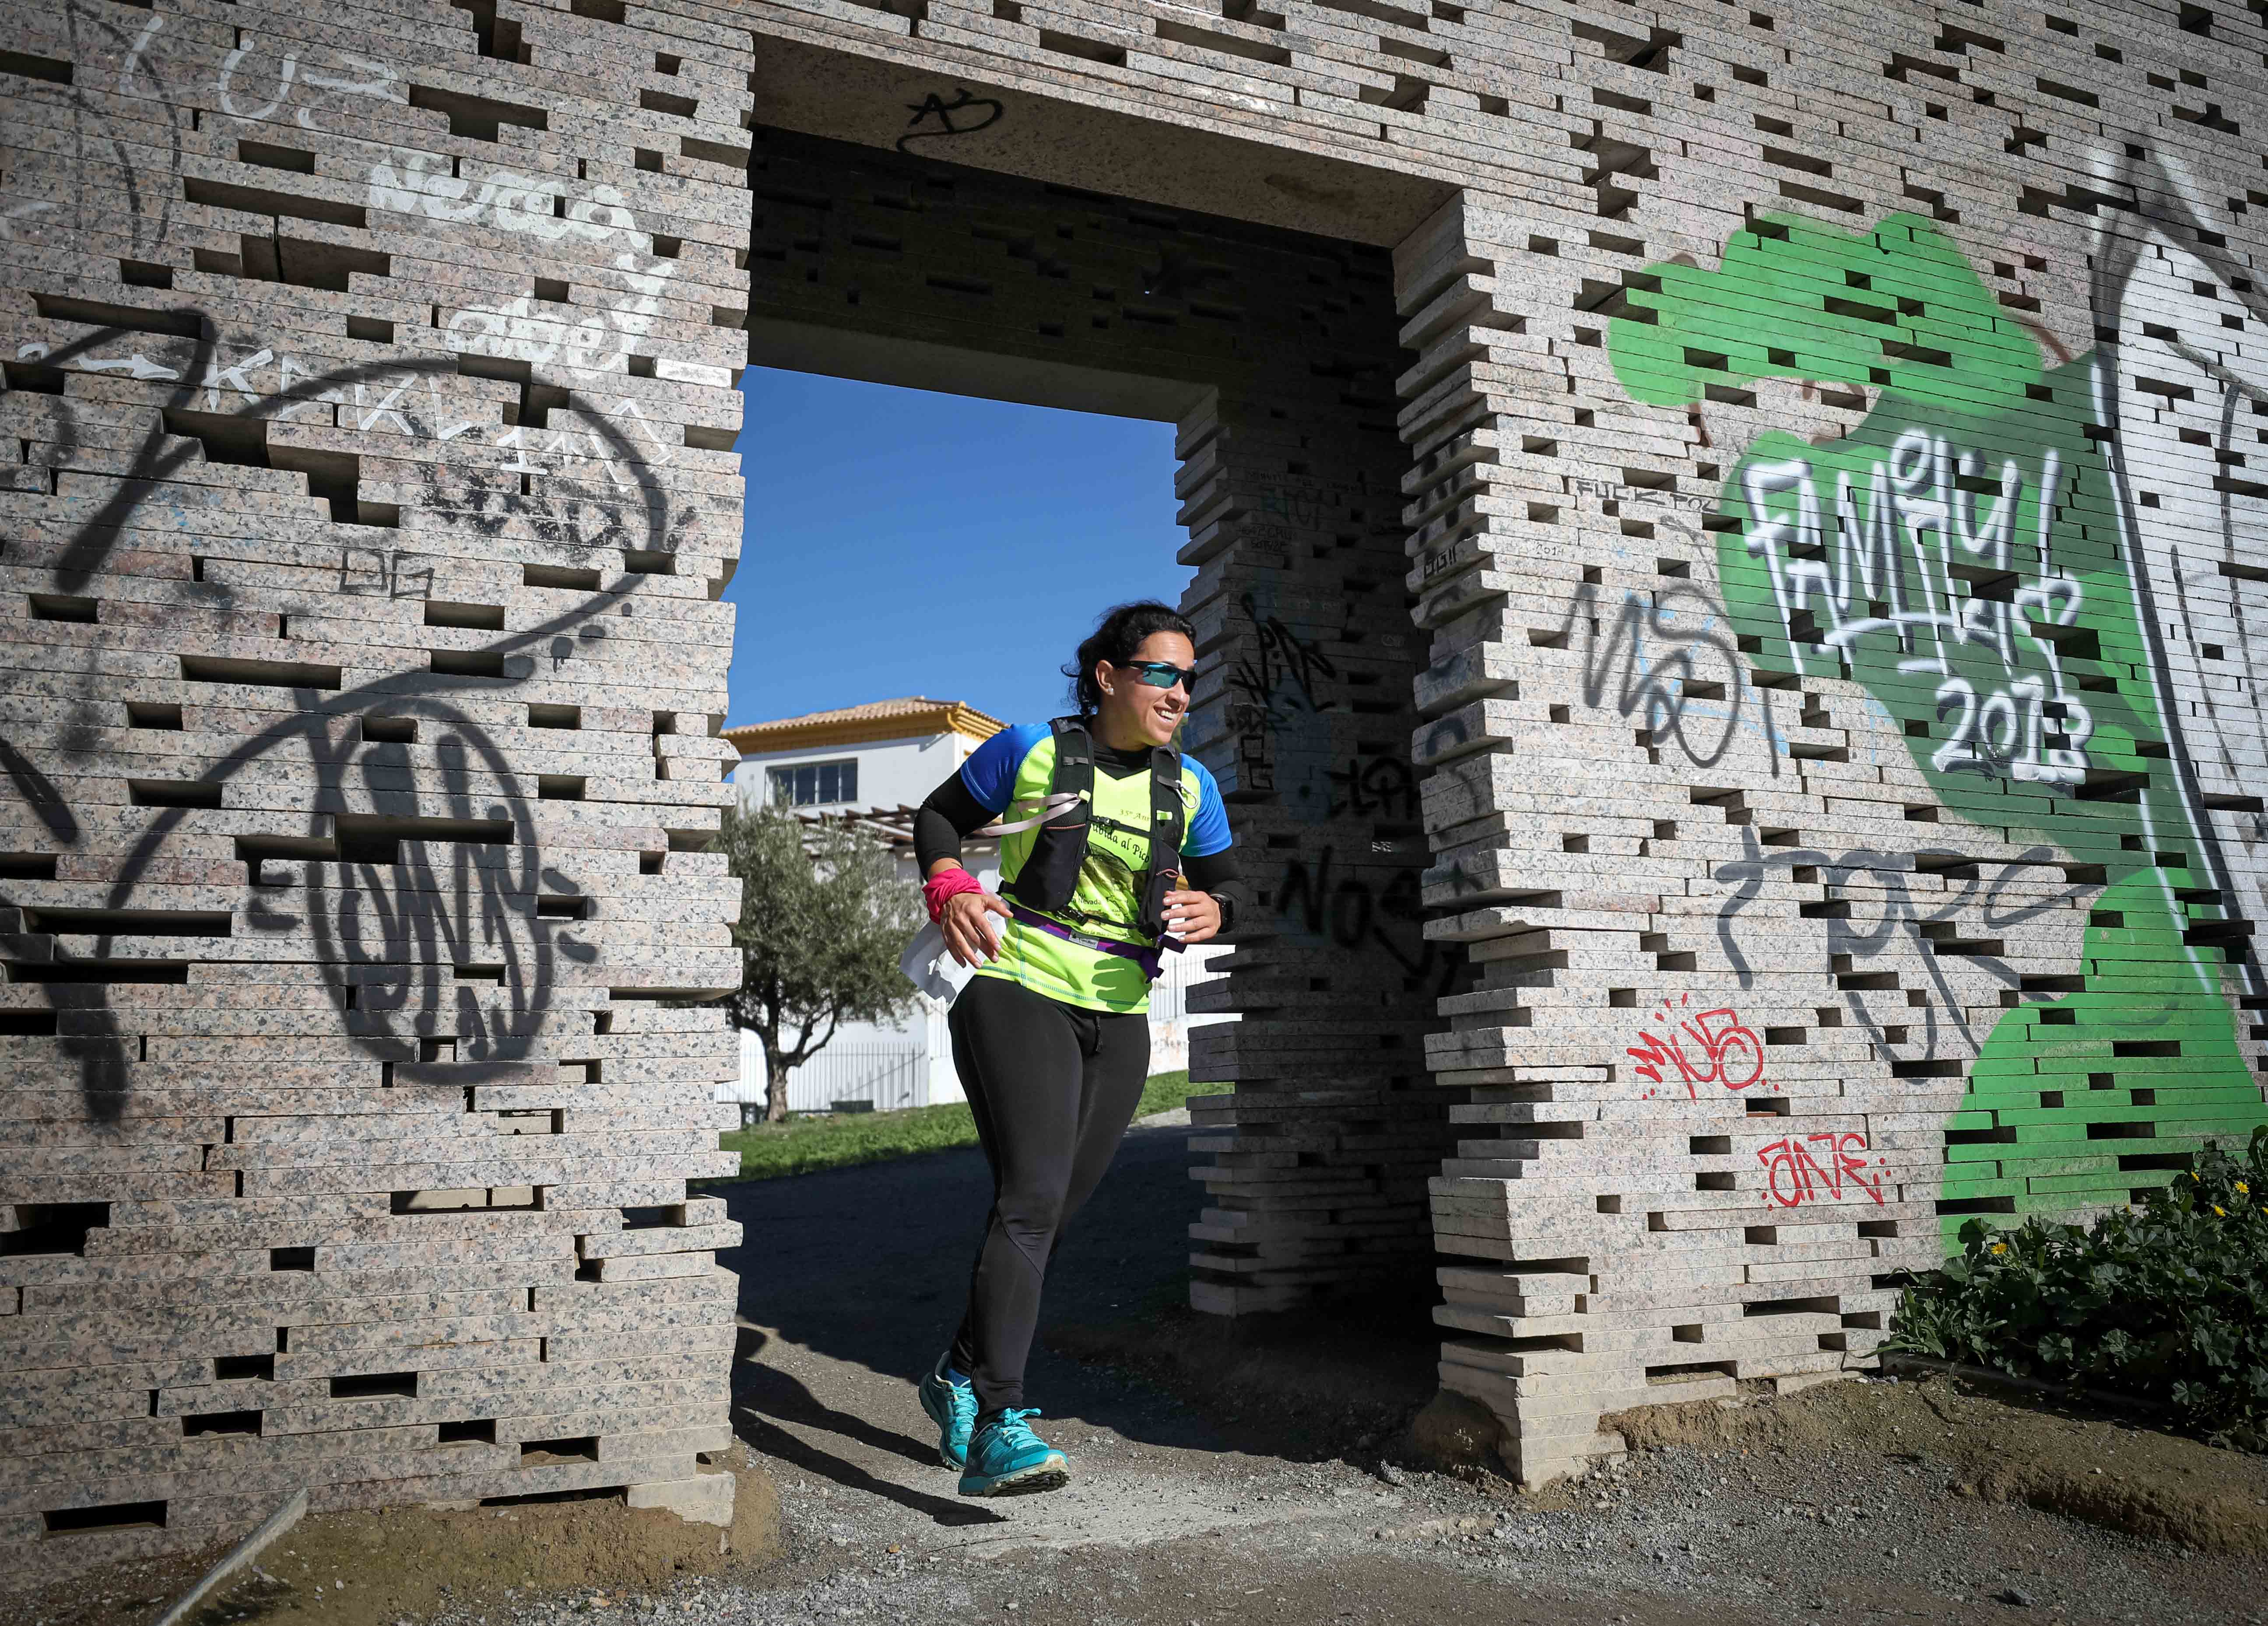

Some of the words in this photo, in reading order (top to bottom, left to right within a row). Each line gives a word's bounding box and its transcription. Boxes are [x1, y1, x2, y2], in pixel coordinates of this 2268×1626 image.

[1576, 479, 1665, 505] FUCK
[1092, 823, 1118, 844] ubida
[1120, 838, 1132, 850] al
[1132, 844, 1150, 863] Pico
